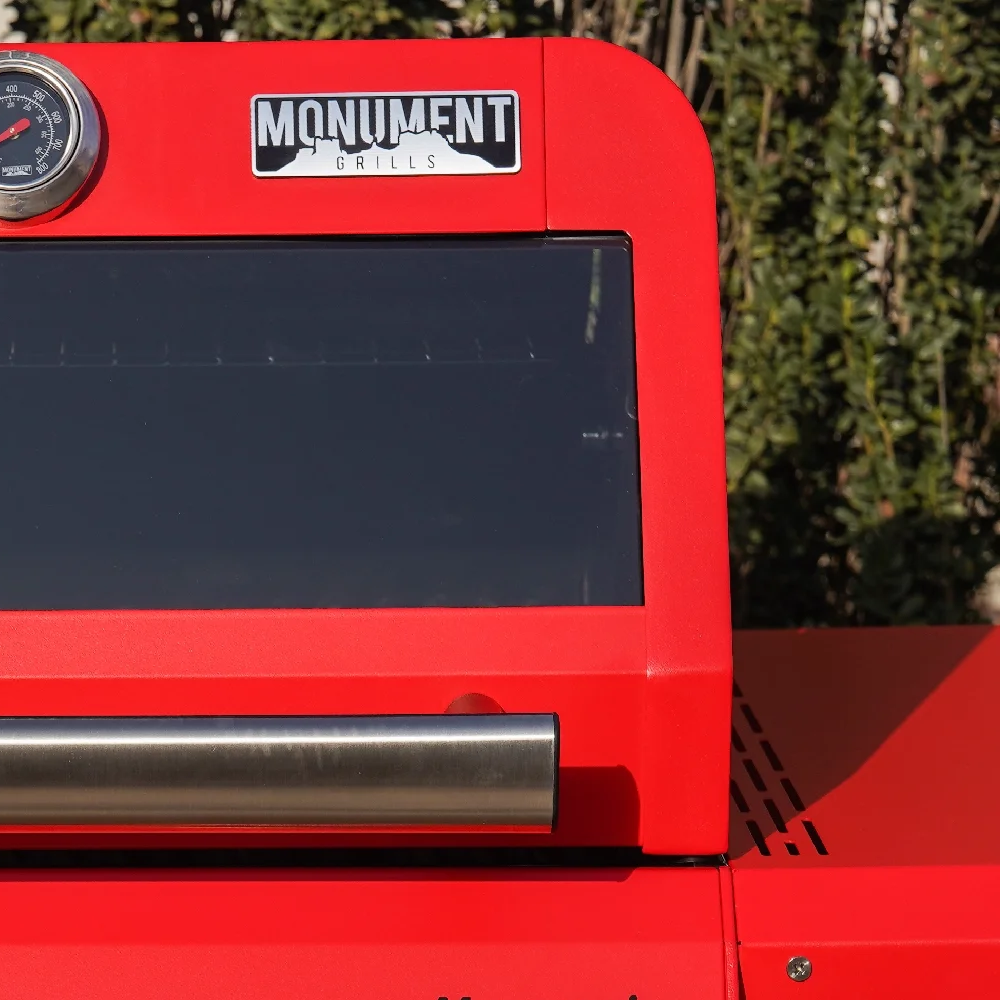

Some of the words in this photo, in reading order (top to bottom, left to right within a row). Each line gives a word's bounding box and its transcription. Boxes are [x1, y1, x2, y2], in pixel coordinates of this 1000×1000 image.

[6, 85, 18, 93] 400
[33, 90, 45, 102] 500
[51, 111, 62, 123] 600
[258, 97, 512, 147] MONUMENT
[53, 139, 63, 150] 700
[36, 162, 48, 174] 800
[337, 155, 435, 170] GRILLS
